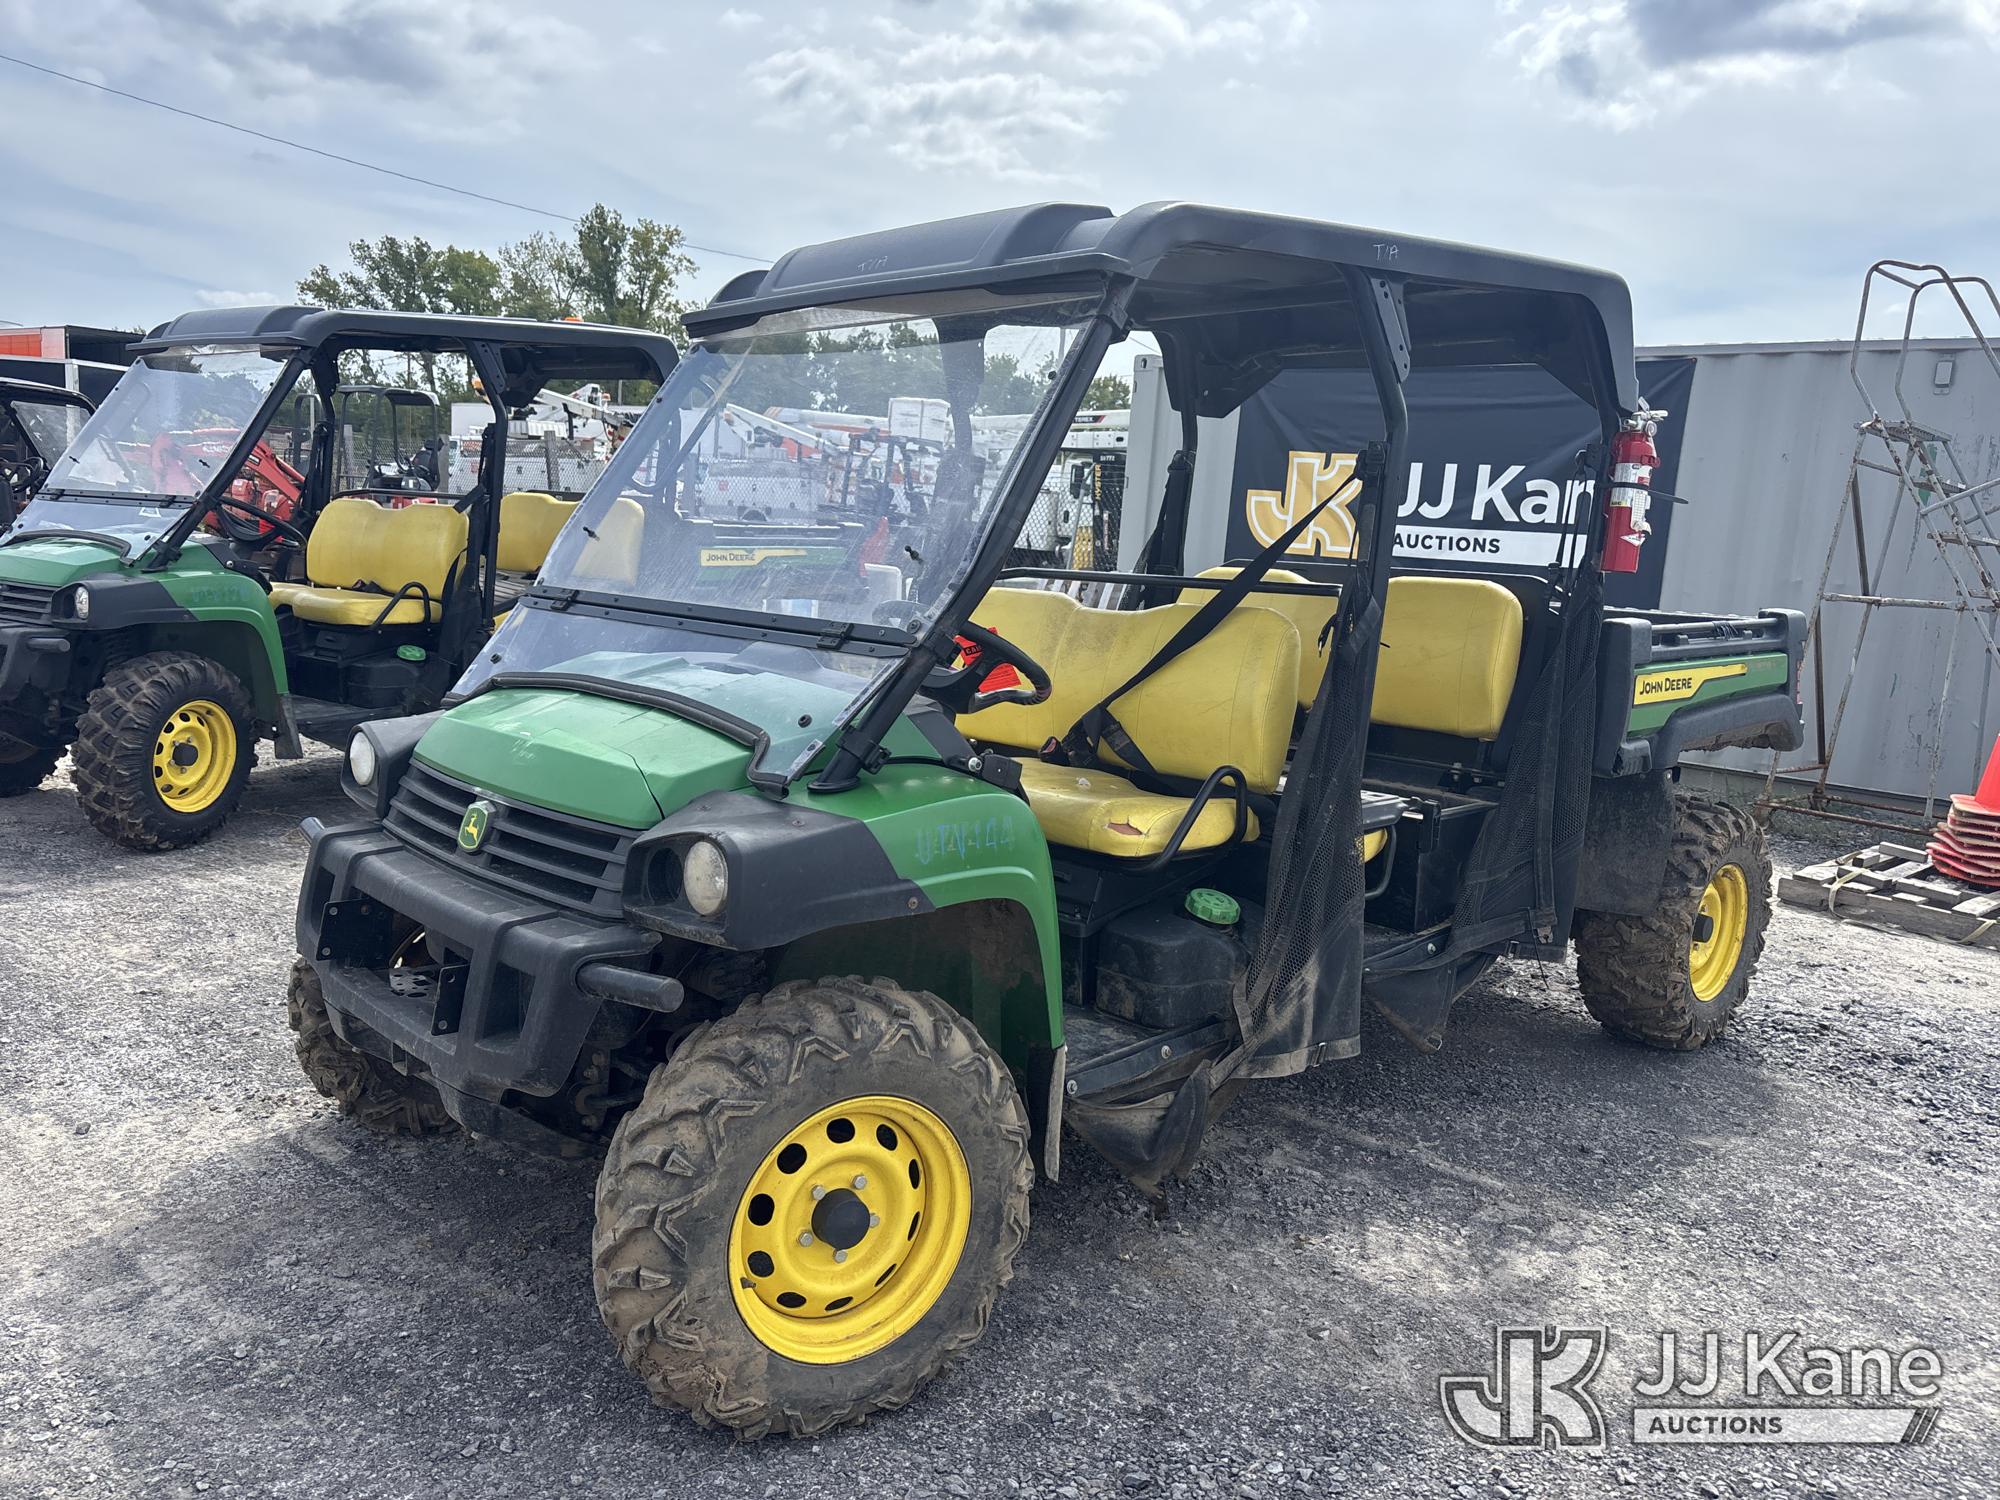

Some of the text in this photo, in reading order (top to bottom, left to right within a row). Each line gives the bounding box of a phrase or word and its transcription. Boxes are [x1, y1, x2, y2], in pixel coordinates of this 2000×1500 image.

[1397, 463, 1458, 519] JJ
[1471, 465, 1596, 525] Kan
[1394, 533, 1501, 554] AUCTIONS
[706, 553, 728, 562] JOHN
[1640, 678, 1692, 695] JOHN DEERE
